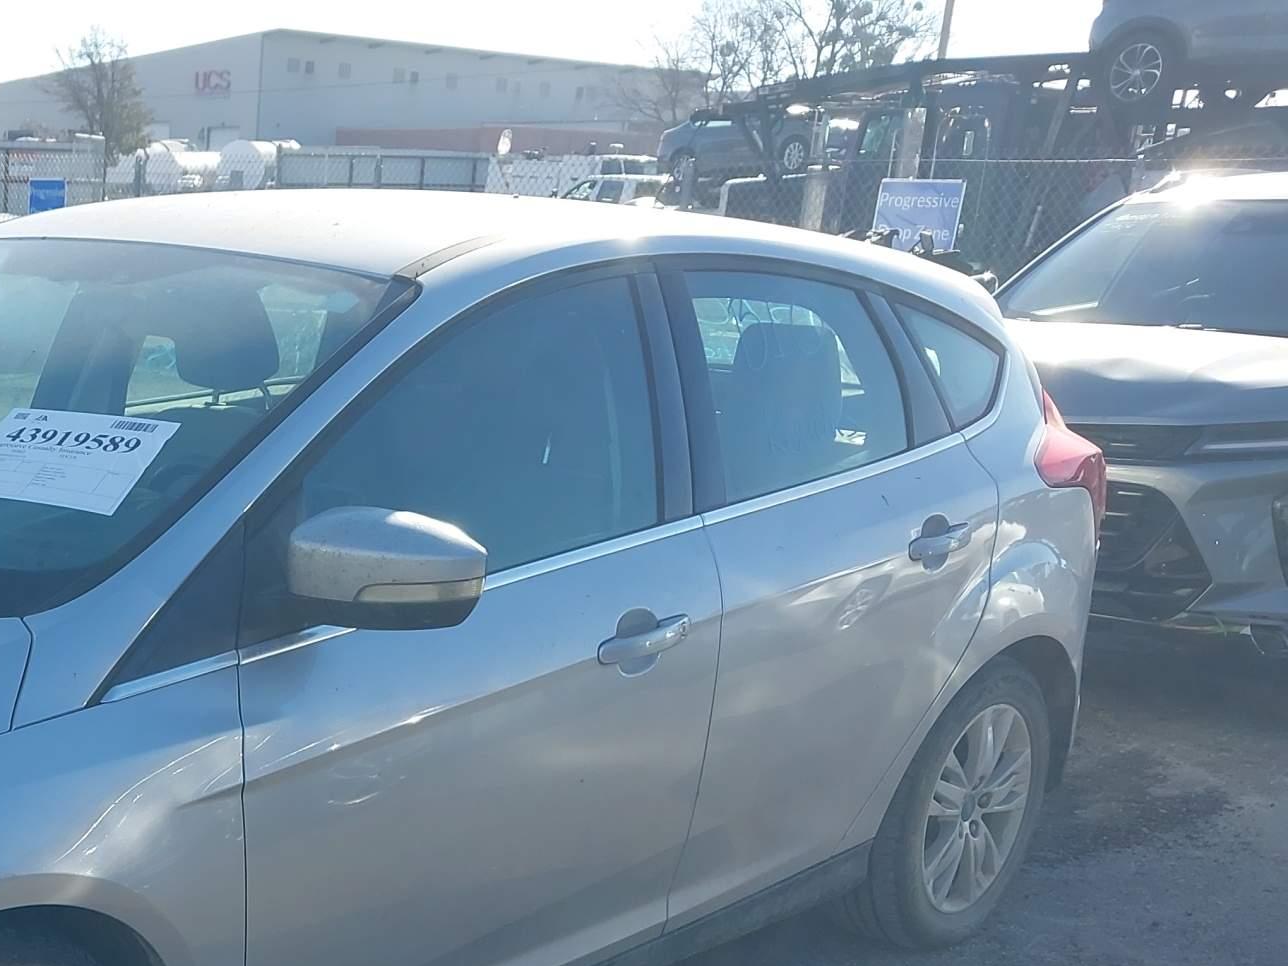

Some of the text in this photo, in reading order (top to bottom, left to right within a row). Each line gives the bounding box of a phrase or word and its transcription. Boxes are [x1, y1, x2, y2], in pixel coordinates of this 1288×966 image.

[195, 70, 231, 89] UCS
[880, 192, 959, 210] Progressive
[913, 224, 950, 241] Zne
[6, 427, 142, 454] 43919589
